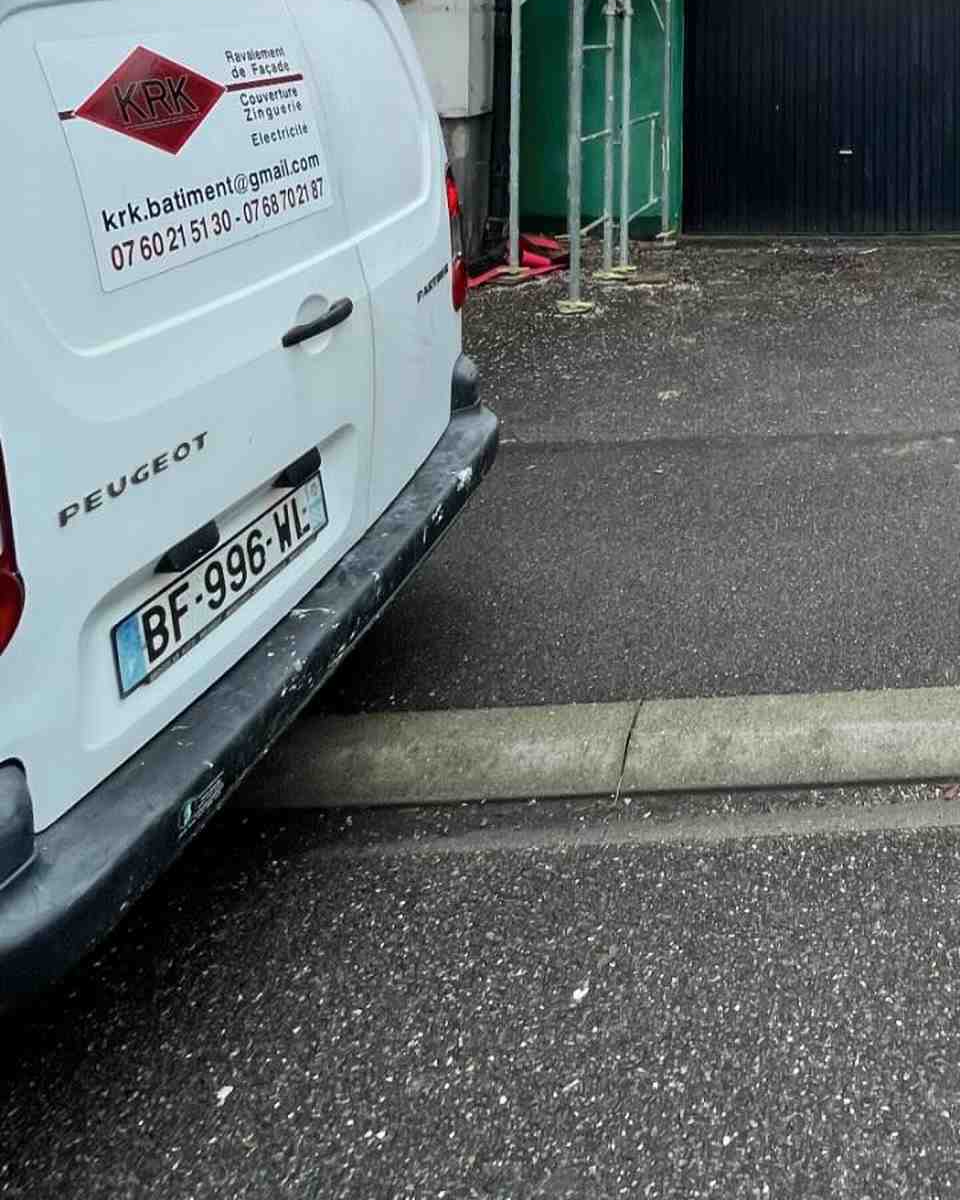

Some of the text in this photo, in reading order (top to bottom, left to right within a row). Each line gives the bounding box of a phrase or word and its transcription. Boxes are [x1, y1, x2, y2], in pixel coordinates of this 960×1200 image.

[225, 47, 285, 63] Ravalement
[232, 61, 290, 79] de Façade
[113, 75, 198, 124] KRK
[240, 88, 298, 107] Couverture
[244, 101, 302, 121] Zinguerie
[102, 153, 319, 232] krk.batiment@gmail.com
[58, 431, 208, 528] PEUGEOT
[142, 498, 310, 664] BF-996-WL
